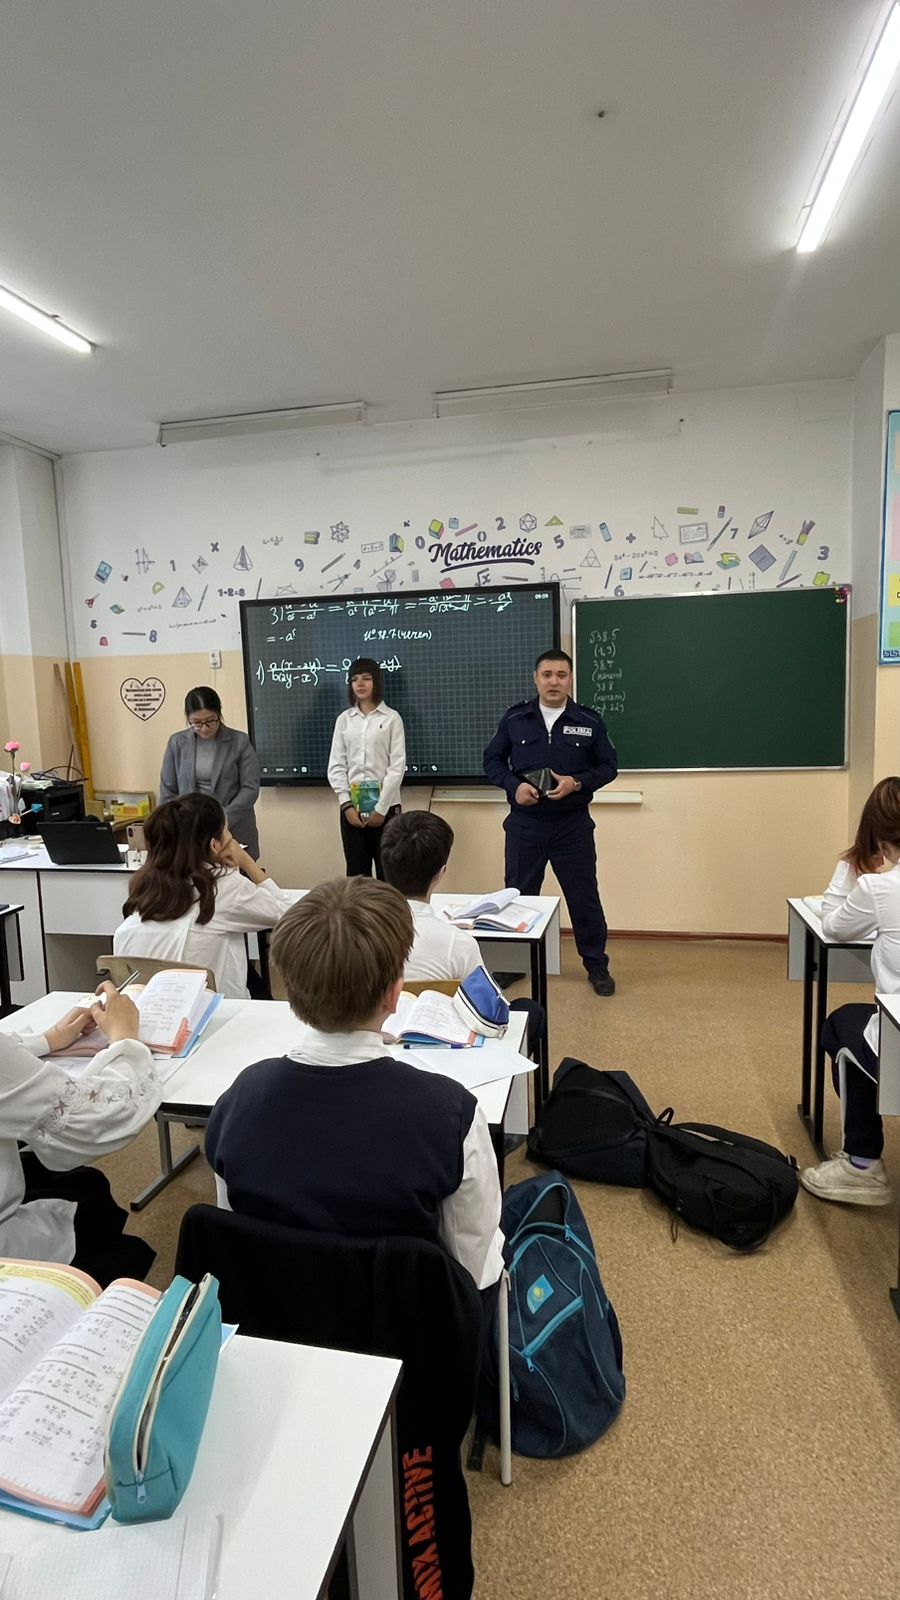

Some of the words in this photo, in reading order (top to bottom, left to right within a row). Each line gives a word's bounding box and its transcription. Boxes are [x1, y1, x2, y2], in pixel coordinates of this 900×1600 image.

[495, 517, 507, 531] 2
[730, 528, 739, 539] 7
[553, 534, 565, 549] 5
[428, 537, 543, 567] Mathematics
[817, 545, 830, 561] 3
[294, 558, 305, 572] 9
[149, 629, 158, 643] 8
